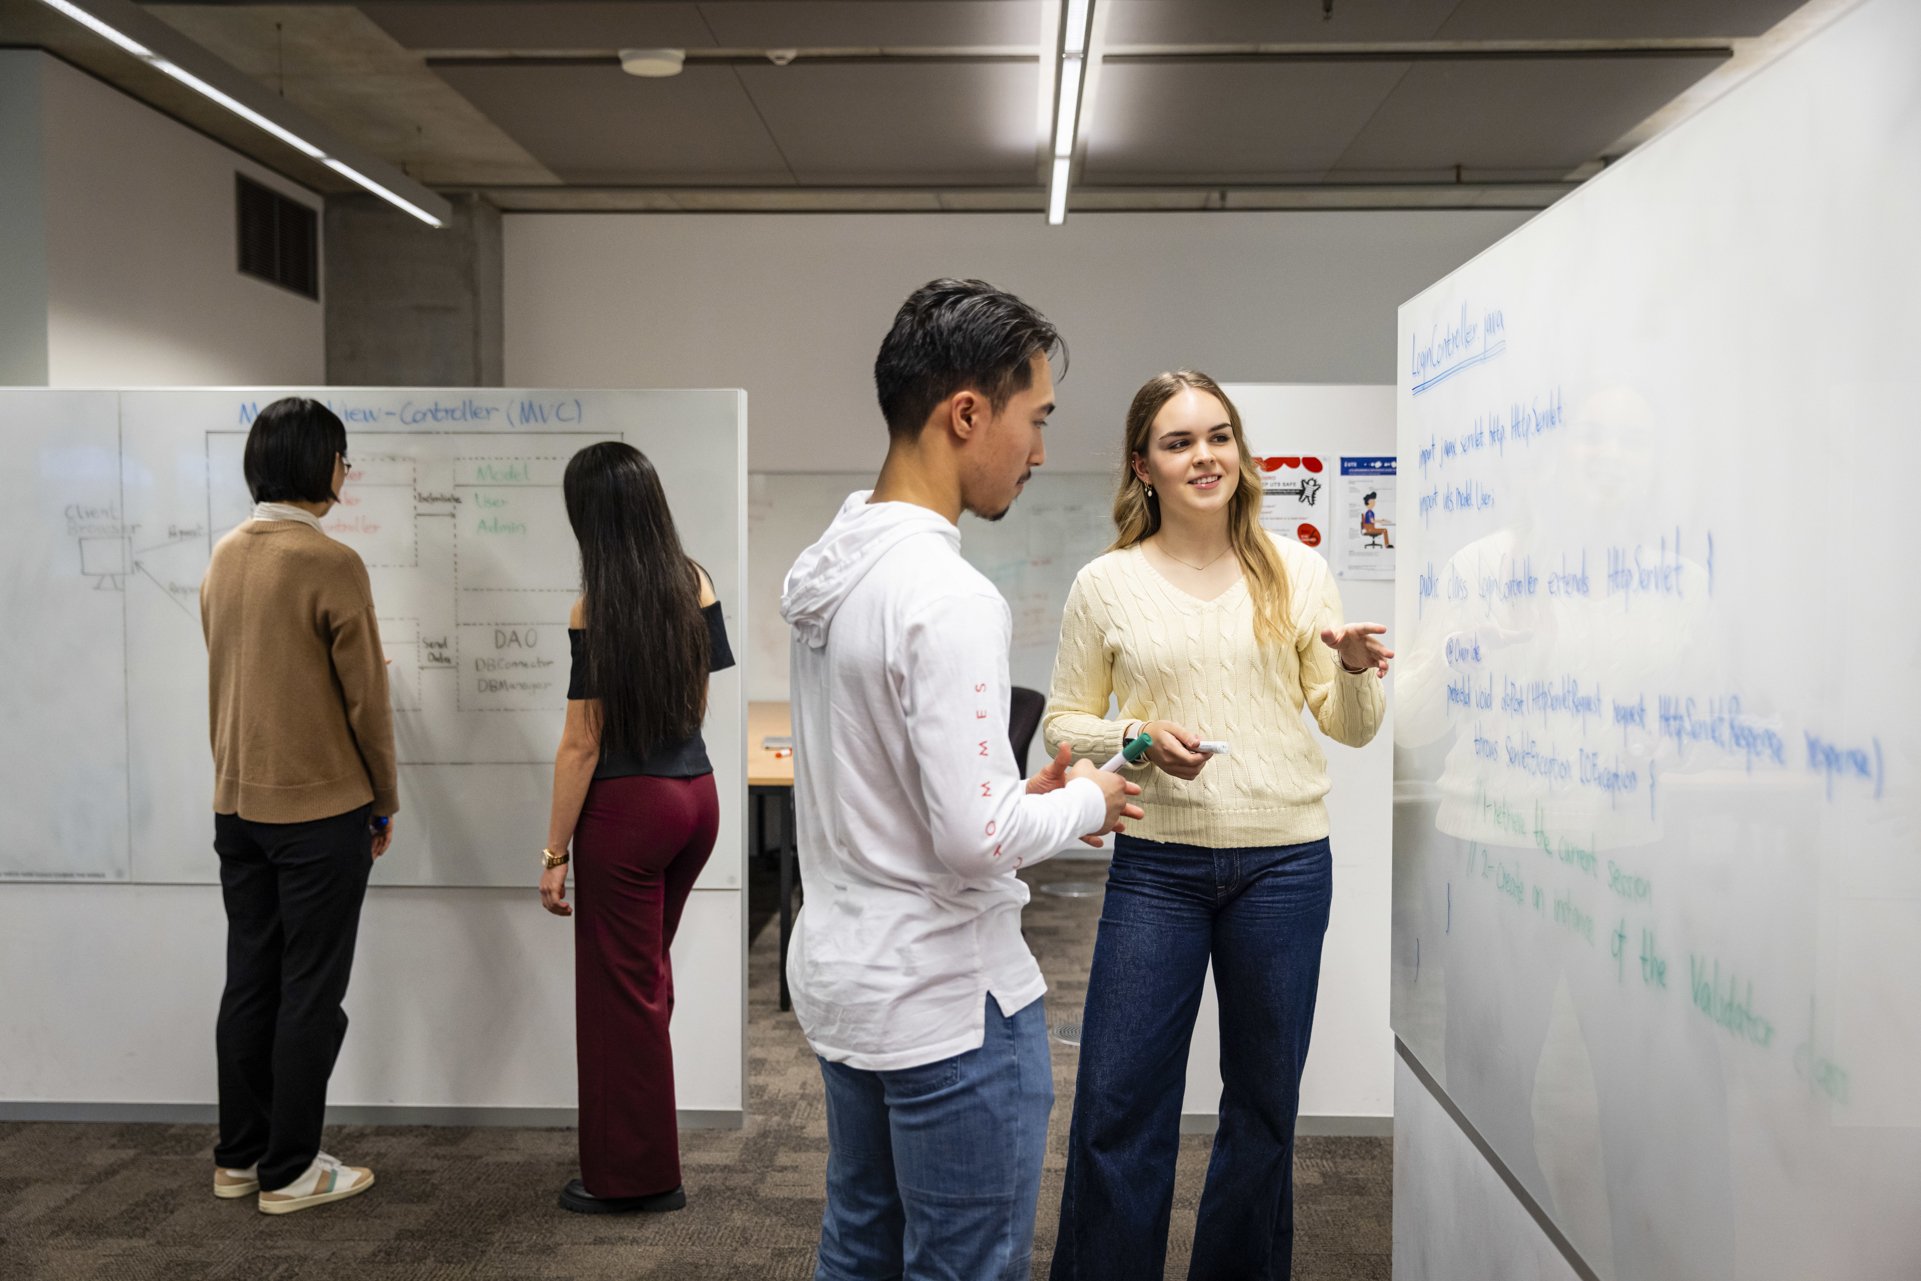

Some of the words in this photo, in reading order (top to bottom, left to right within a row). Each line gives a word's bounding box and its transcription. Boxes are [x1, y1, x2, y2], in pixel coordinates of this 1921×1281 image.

[506, 399, 583, 426] (MVC)
[476, 461, 530, 482] Model
[65, 501, 120, 520] Client
[474, 492, 507, 509] User
[476, 519, 527, 536] Admin
[1418, 560, 1440, 621] public
[1447, 560, 1468, 600] class
[1547, 548, 1591, 598] extends
[422, 636, 448, 650] Send
[494, 628, 538, 650] DAO
[1474, 671, 1493, 711] void
[1532, 797, 1553, 856] the
[1610, 917, 1627, 985] of
[1639, 927, 1667, 990] the
